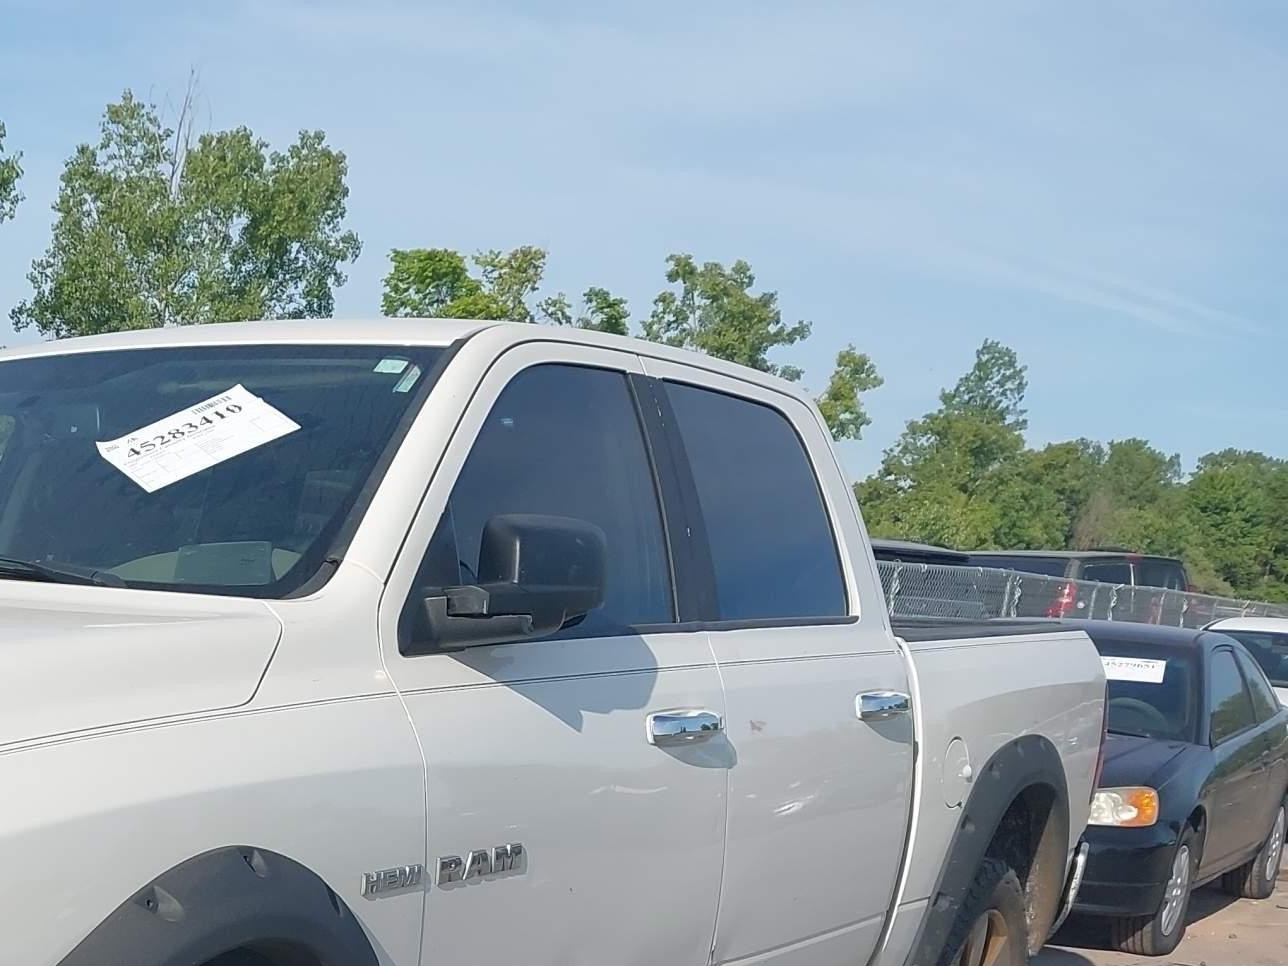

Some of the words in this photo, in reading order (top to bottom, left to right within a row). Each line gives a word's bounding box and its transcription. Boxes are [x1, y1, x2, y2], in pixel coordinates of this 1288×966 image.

[127, 404, 243, 458] 45283410
[361, 864, 424, 896] HEMI
[436, 843, 522, 887] RAM
